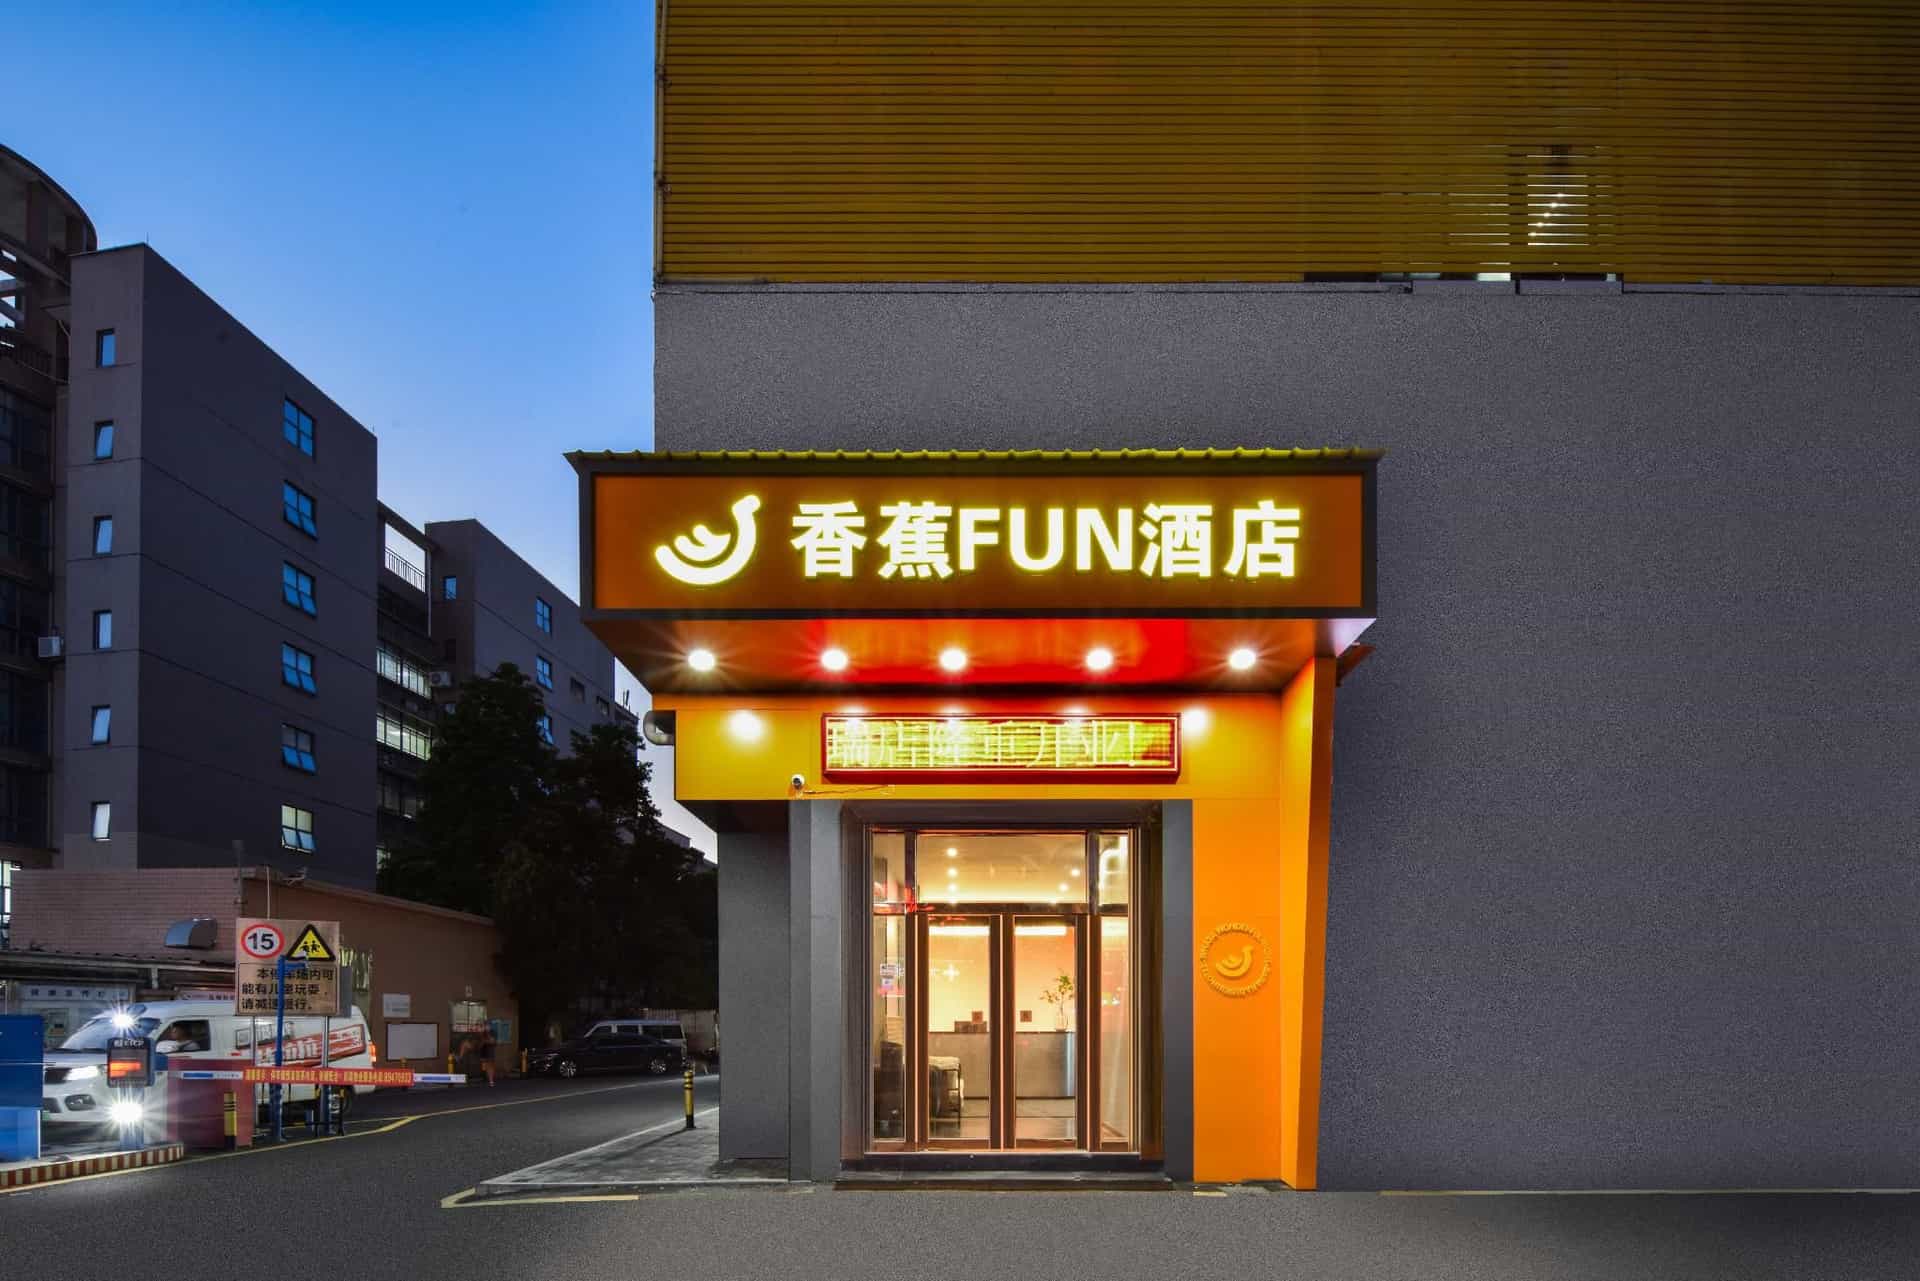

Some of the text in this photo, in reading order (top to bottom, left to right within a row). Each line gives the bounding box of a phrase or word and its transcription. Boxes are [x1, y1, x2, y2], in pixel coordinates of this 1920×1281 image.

[790, 500, 1300, 578] 香蕉FUN酒店
[248, 933, 274, 950] 15
